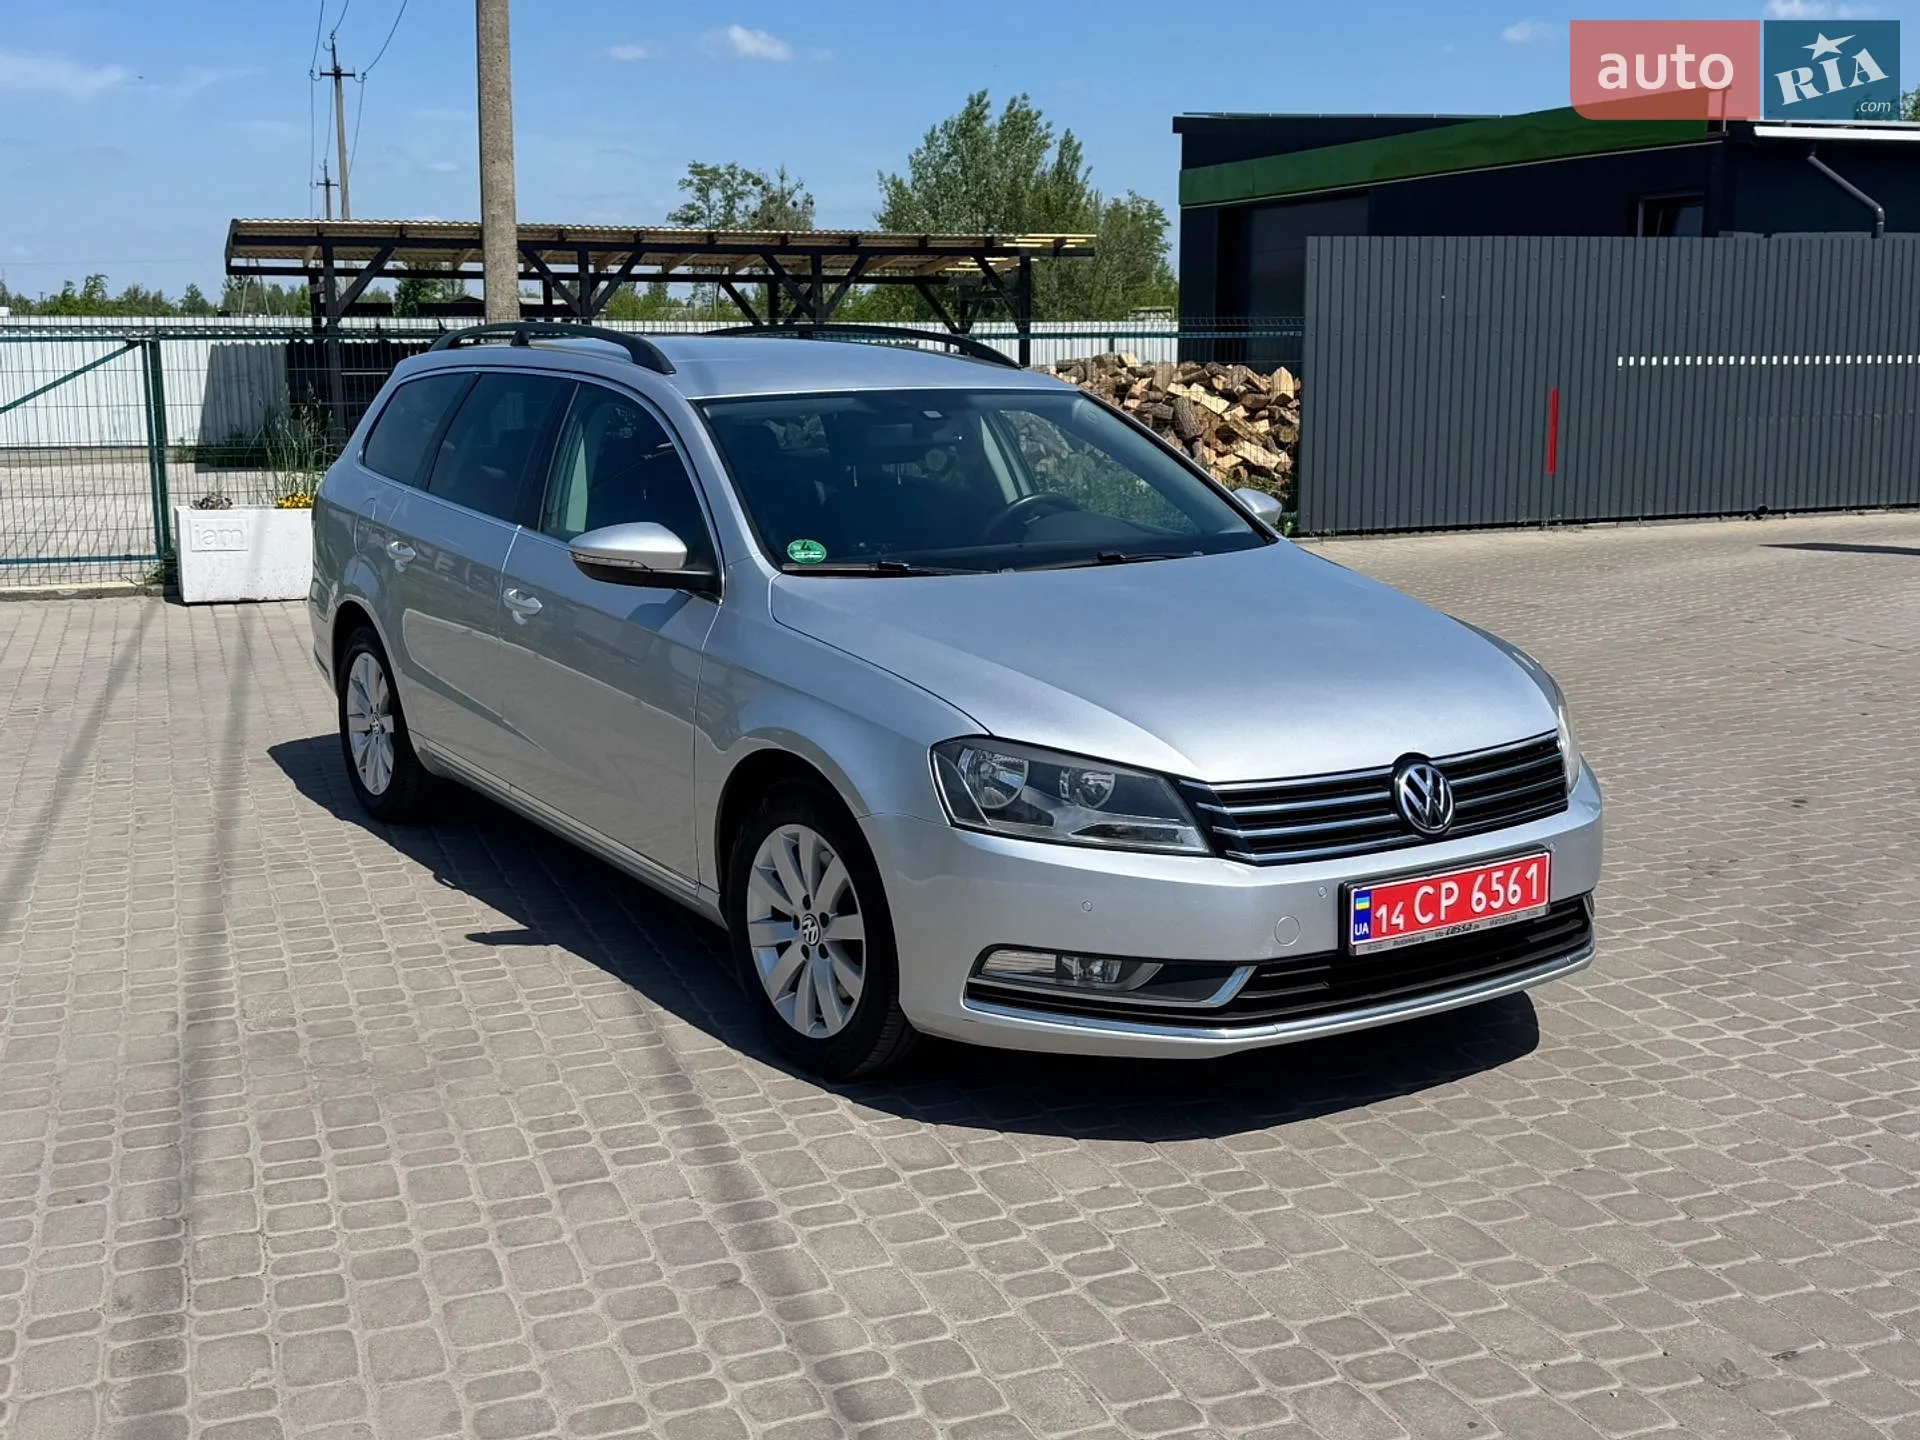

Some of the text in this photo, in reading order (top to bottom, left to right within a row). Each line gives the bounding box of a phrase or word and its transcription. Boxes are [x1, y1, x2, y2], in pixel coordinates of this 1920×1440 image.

[1399, 764, 1452, 833] VW
[1354, 922, 1369, 936] UA
[1375, 863, 1539, 934] 14 CP 6561
